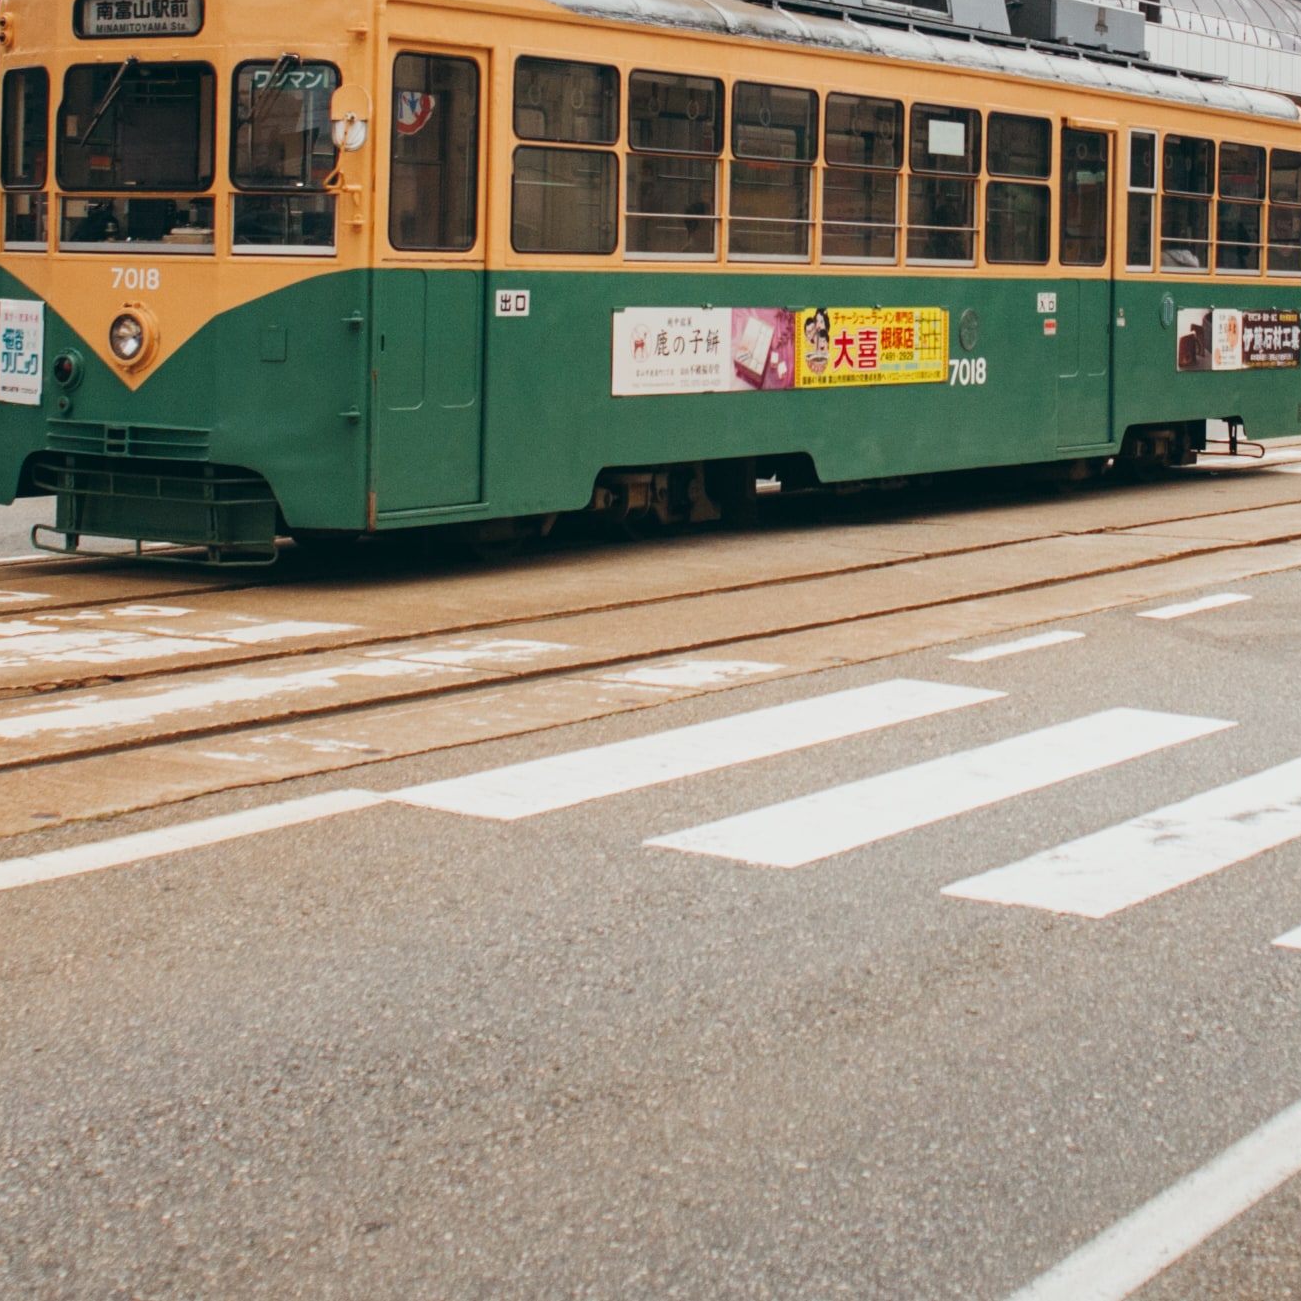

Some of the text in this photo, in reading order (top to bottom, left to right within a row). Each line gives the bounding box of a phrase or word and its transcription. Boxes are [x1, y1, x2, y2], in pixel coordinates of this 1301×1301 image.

[95, 21, 168, 33] MINAMITOYAMA
[111, 267, 160, 290] 7018
[500, 293, 526, 312] 出口
[1039, 300, 1055, 312] 入口
[833, 311, 914, 325] チャーシューラーメン専門店
[655, 328, 721, 357] 鹿の子餅
[880, 326, 914, 349] 根塚店
[834, 330, 878, 369] 大喜
[1, 351, 39, 376] クリニック
[948, 357, 987, 386] 7018
